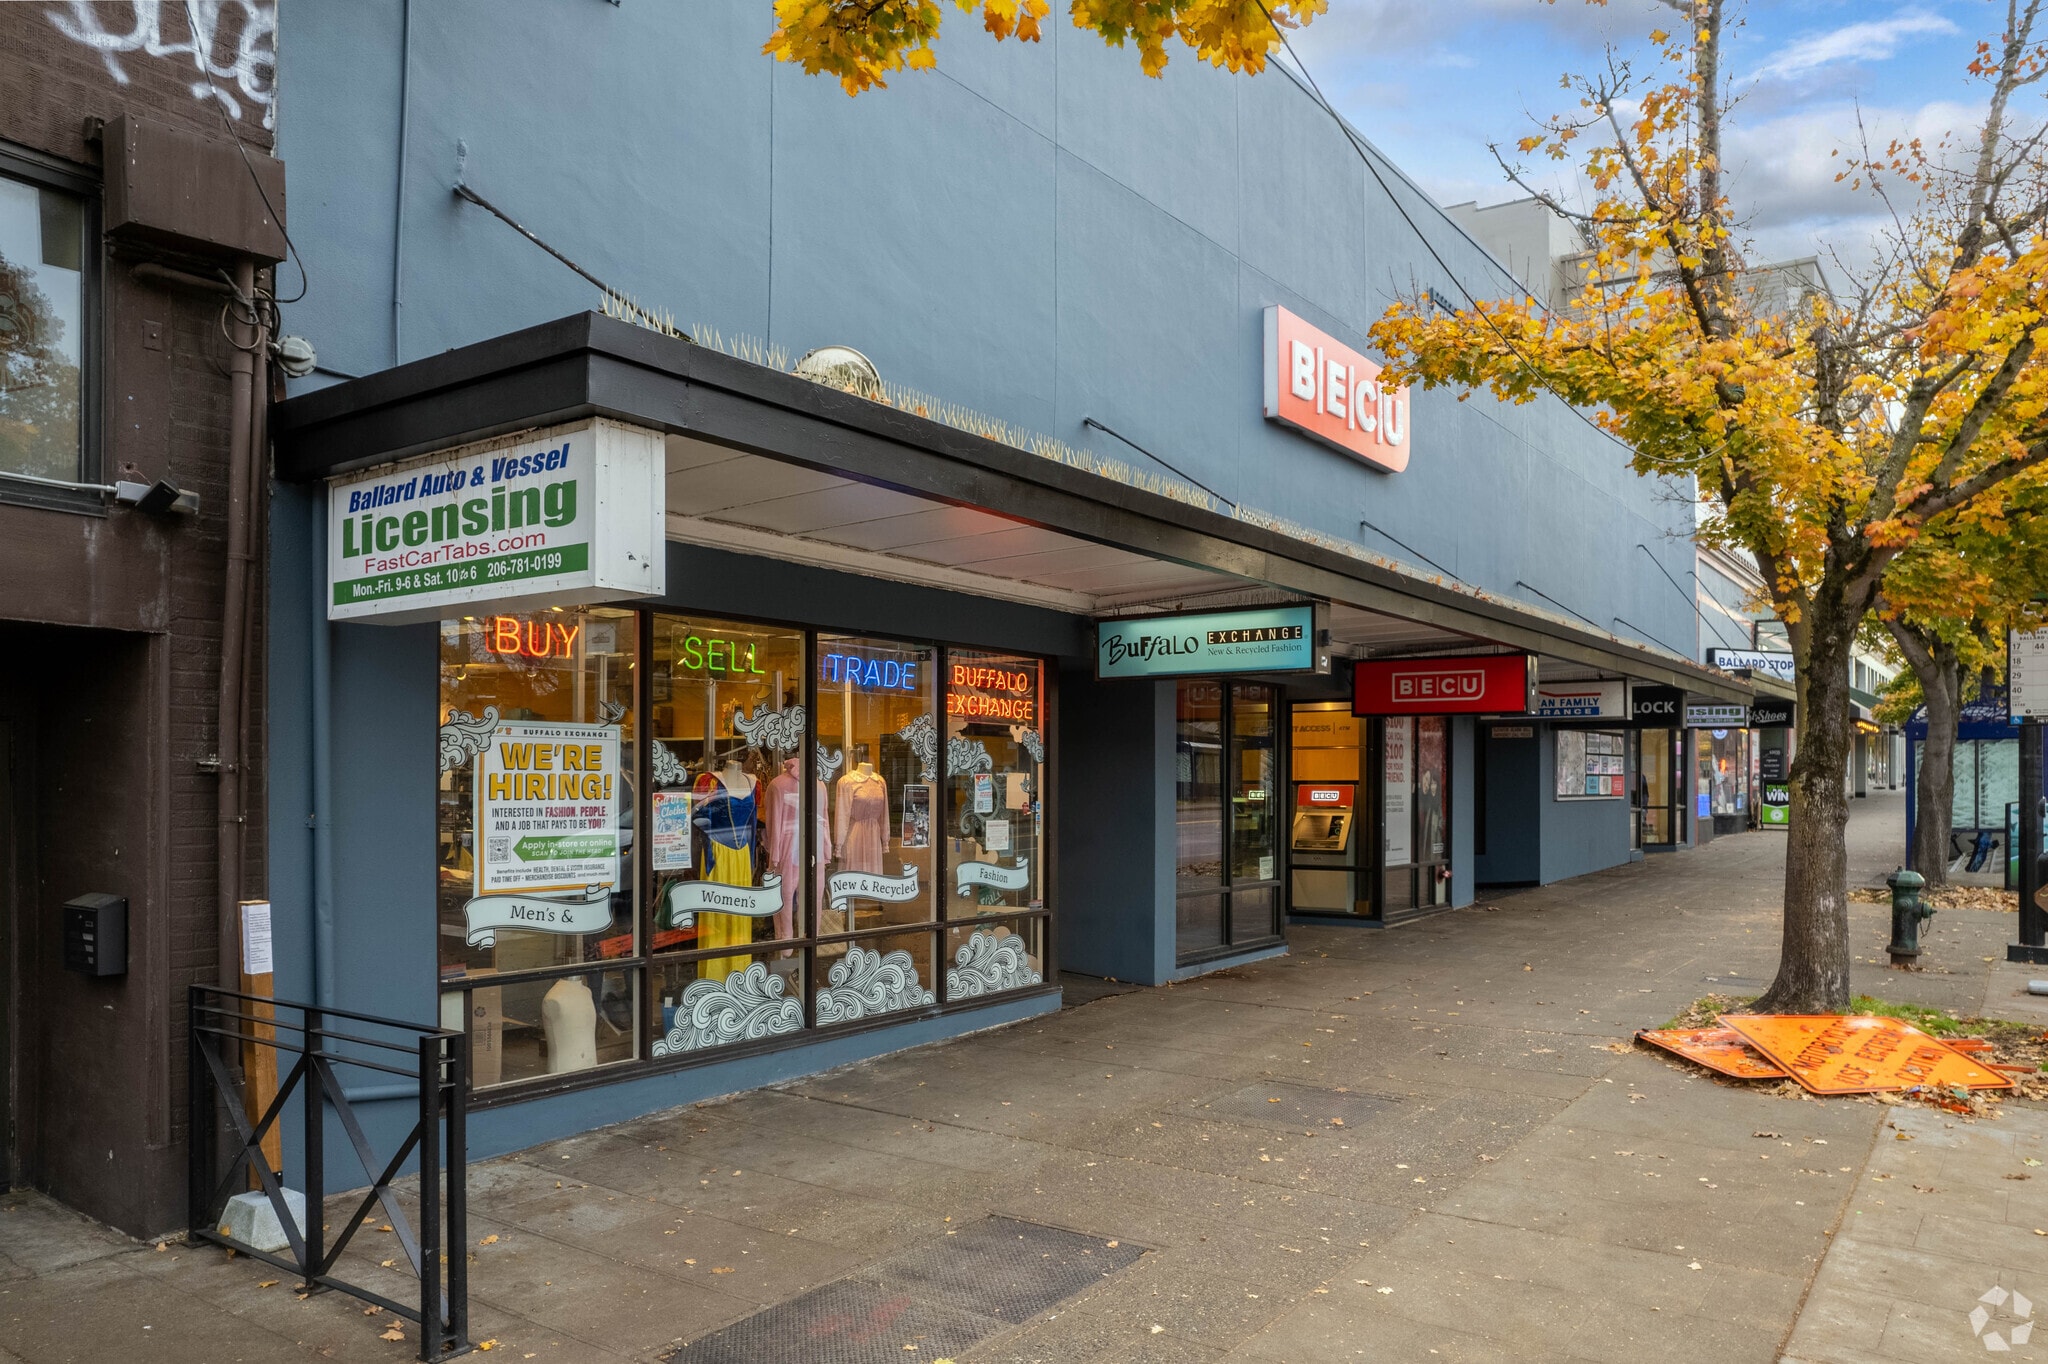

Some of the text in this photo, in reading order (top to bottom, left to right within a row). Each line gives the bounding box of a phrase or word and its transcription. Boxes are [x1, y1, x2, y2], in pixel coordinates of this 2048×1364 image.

[1291, 339, 1404, 446] BECU
[349, 443, 570, 513] Ballard Auto & Vessel
[342, 479, 578, 559] Licensing
[365, 532, 546, 575] FastCarTabs.com
[395, 574, 412, 592] 9-6
[413, 573, 422, 589] &
[423, 570, 443, 587] Sat.
[446, 568, 458, 584] 10
[470, 566, 477, 580] 6
[487, 552, 562, 579] 206-781-0199
[495, 615, 579, 659] BUY
[1207, 627, 1301, 645] EXCHANGE
[684, 635, 766, 676] SELL
[1208, 643, 1302, 656] New & Recycled Fashion
[826, 652, 917, 691] TRADE
[1718, 656, 1766, 669] BALLARD
[953, 664, 1029, 693] BUFFALO
[1399, 677, 1478, 696] BECU
[2012, 686, 2022, 694] 40
[947, 692, 1033, 720] EXCHANGE
[1560, 698, 1600, 707] FAMILY
[1633, 701, 1675, 714] LOCK
[1543, 708, 1592, 716] RANCE
[523, 729, 608, 738] BUFFALO EXCHANGE
[500, 742, 603, 771] WE'RE
[489, 772, 612, 801] HIRING!
[1766, 792, 1789, 802] WIN
[492, 808, 534, 818] INTERESTED
[536, 807, 543, 817] IN
[495, 818, 606, 831] AND A JOB THAT PAYS TO BE YOU?
[522, 841, 546, 850] Apply
[547, 839, 578, 849] in-store
[590, 838, 613, 846] online
[980, 867, 1008, 884] Fashion
[833, 879, 917, 897] New & Recycled
[701, 890, 756, 909] Women's
[510, 905, 574, 923] Men's &
